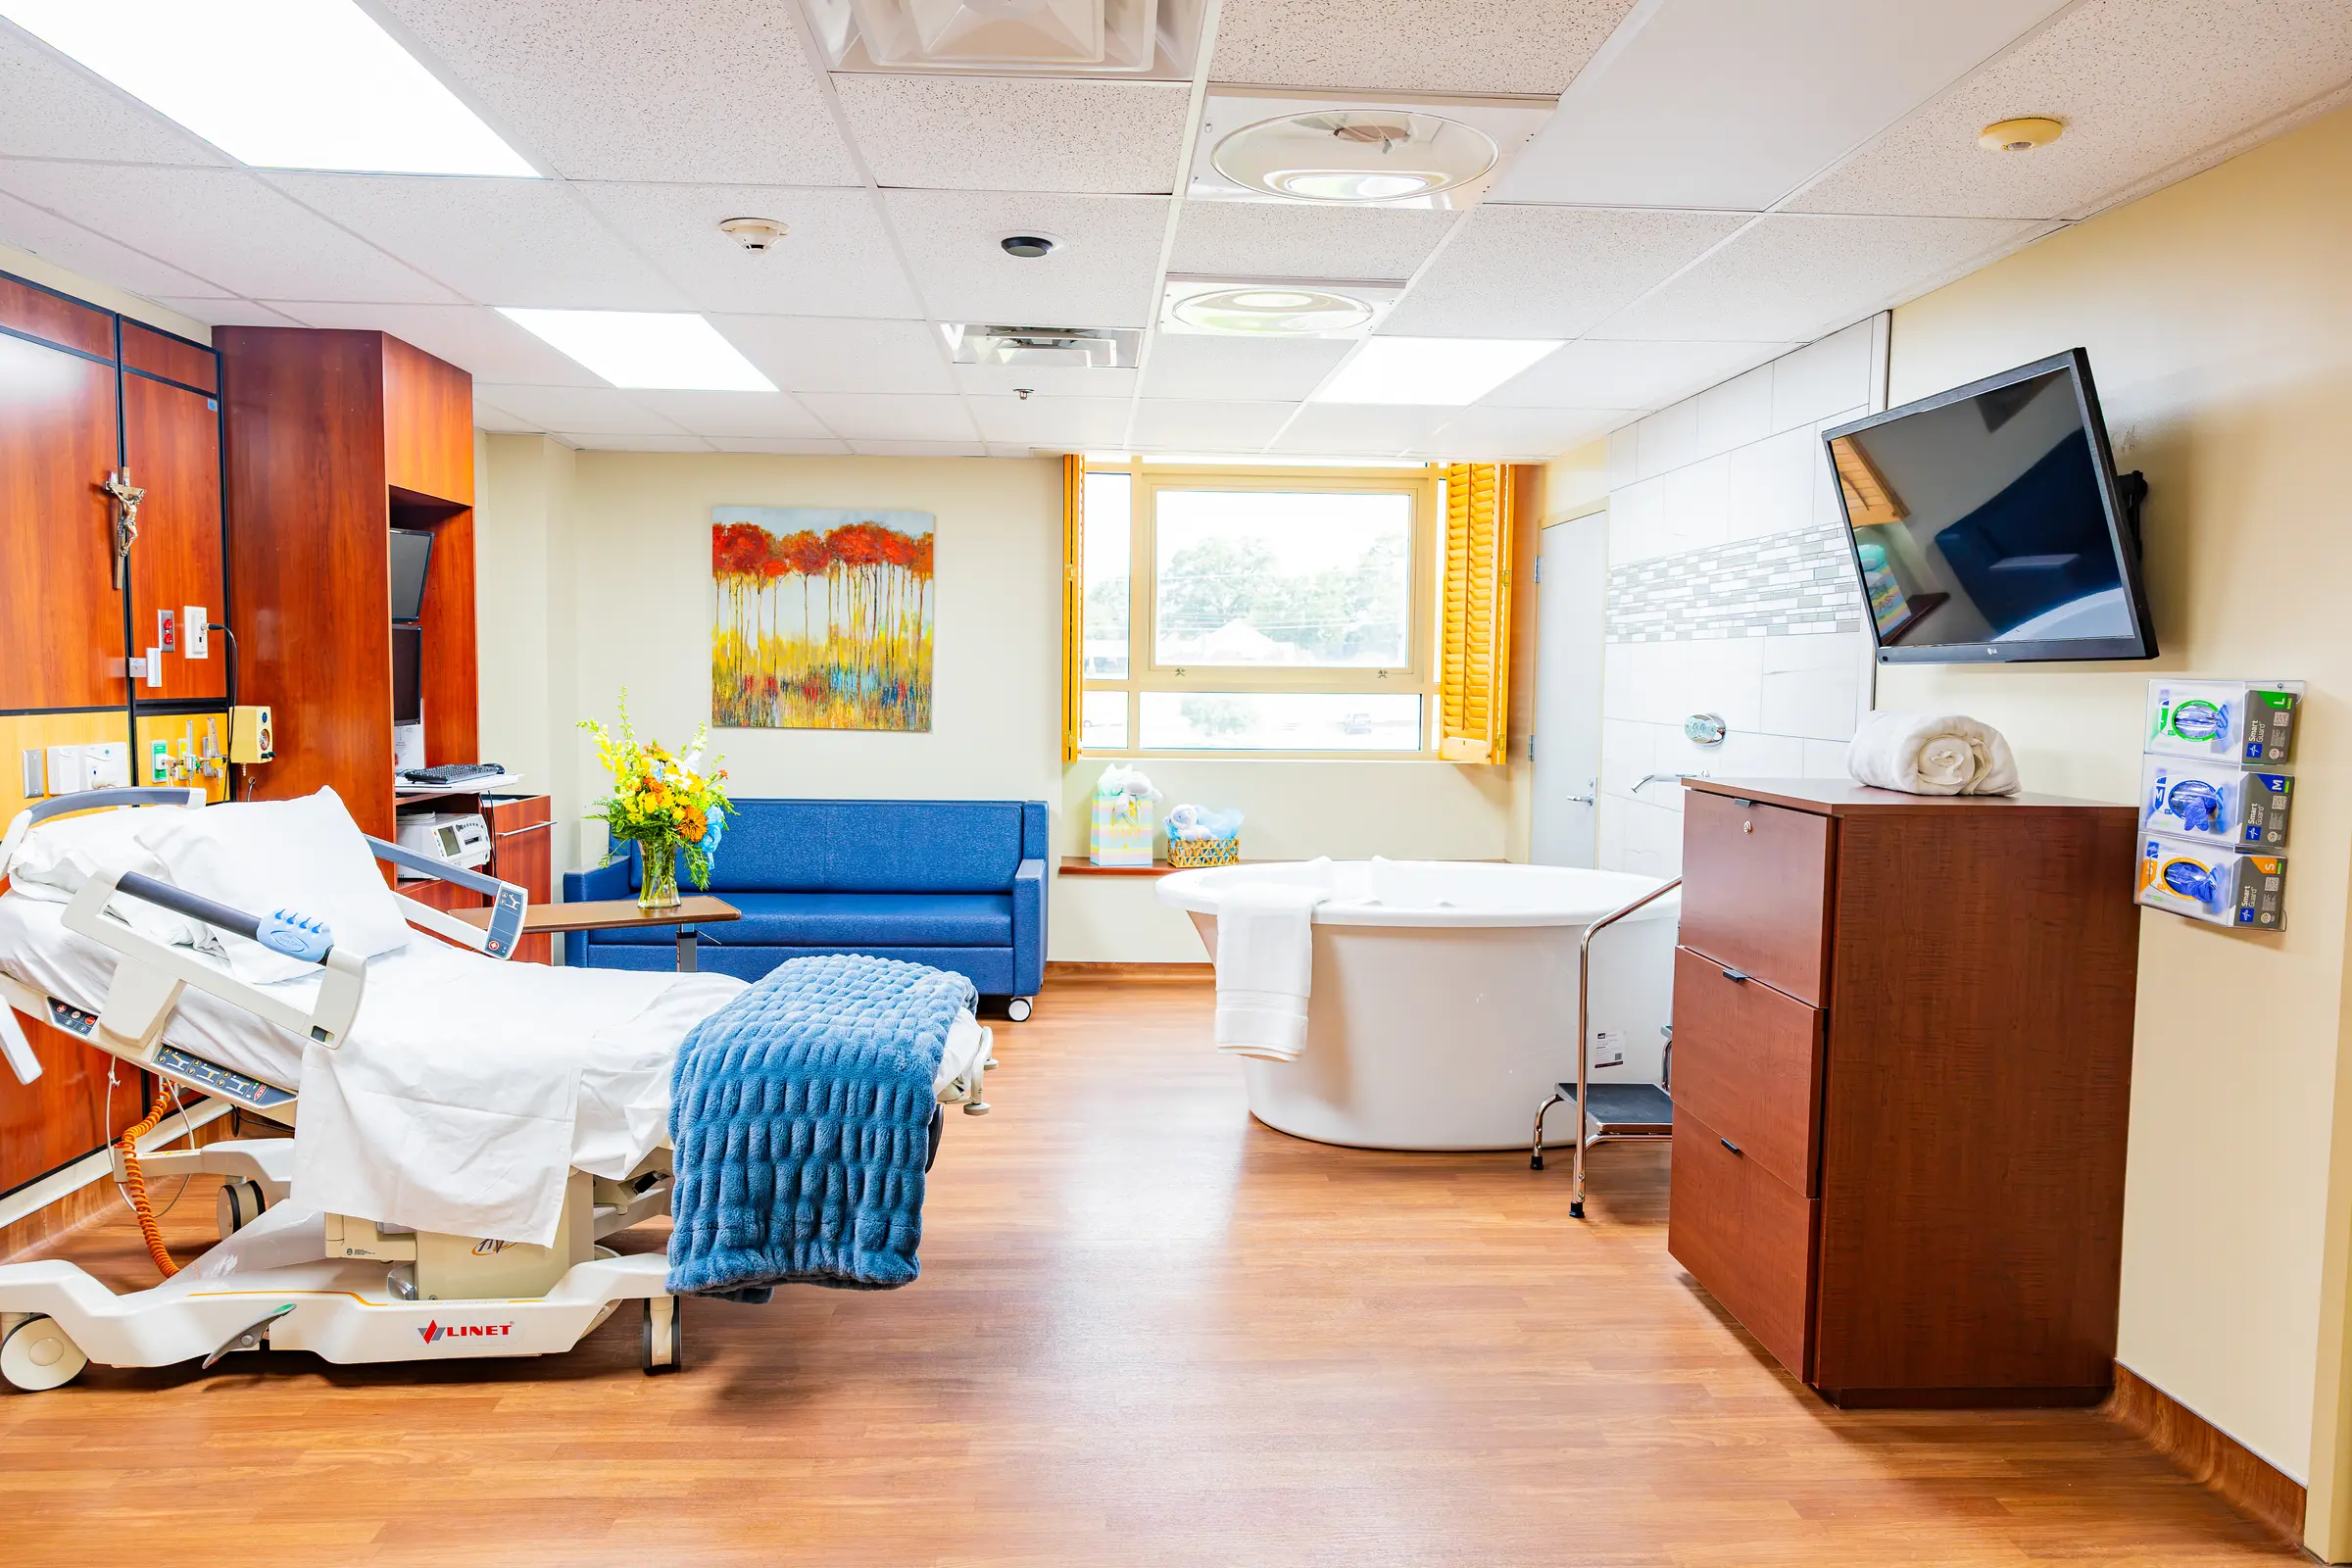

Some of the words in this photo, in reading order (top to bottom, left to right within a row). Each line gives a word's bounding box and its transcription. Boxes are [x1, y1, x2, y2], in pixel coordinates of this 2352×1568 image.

[2249, 720, 2258, 742] Smart
[2256, 723, 2266, 742] Guard
[2272, 779, 2283, 790] M
[2156, 789, 2163, 802] M
[2248, 804, 2257, 824] Smart
[2241, 885, 2250, 906] Smart
[447, 1325, 512, 1337] LINET
